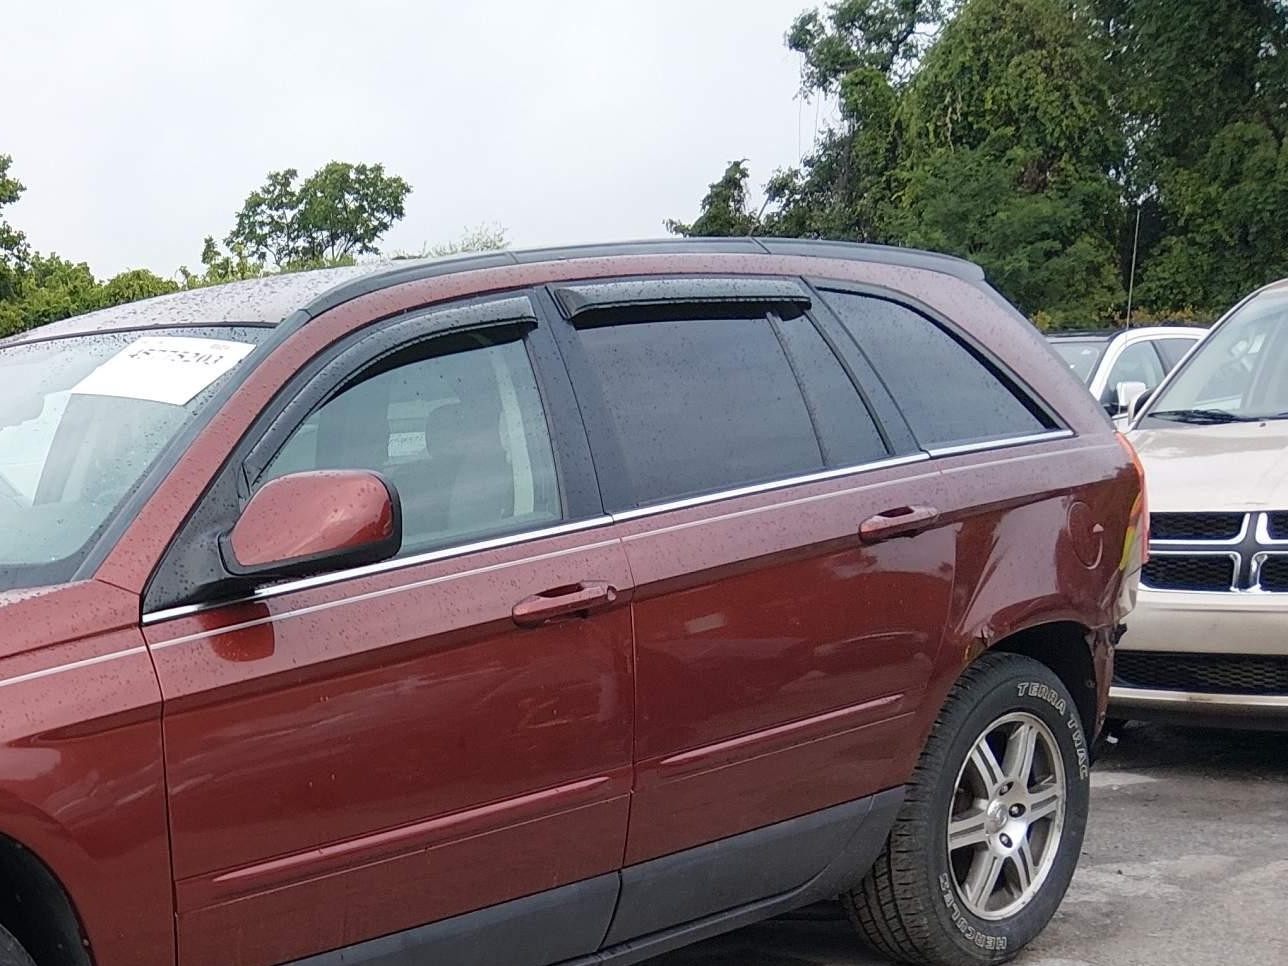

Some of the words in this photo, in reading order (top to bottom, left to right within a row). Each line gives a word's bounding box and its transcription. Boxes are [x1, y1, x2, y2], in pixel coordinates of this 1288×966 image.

[1016, 681, 1068, 717] TERRA
[1066, 718, 1090, 780] TRAC
[938, 872, 1008, 950] HERCULES
